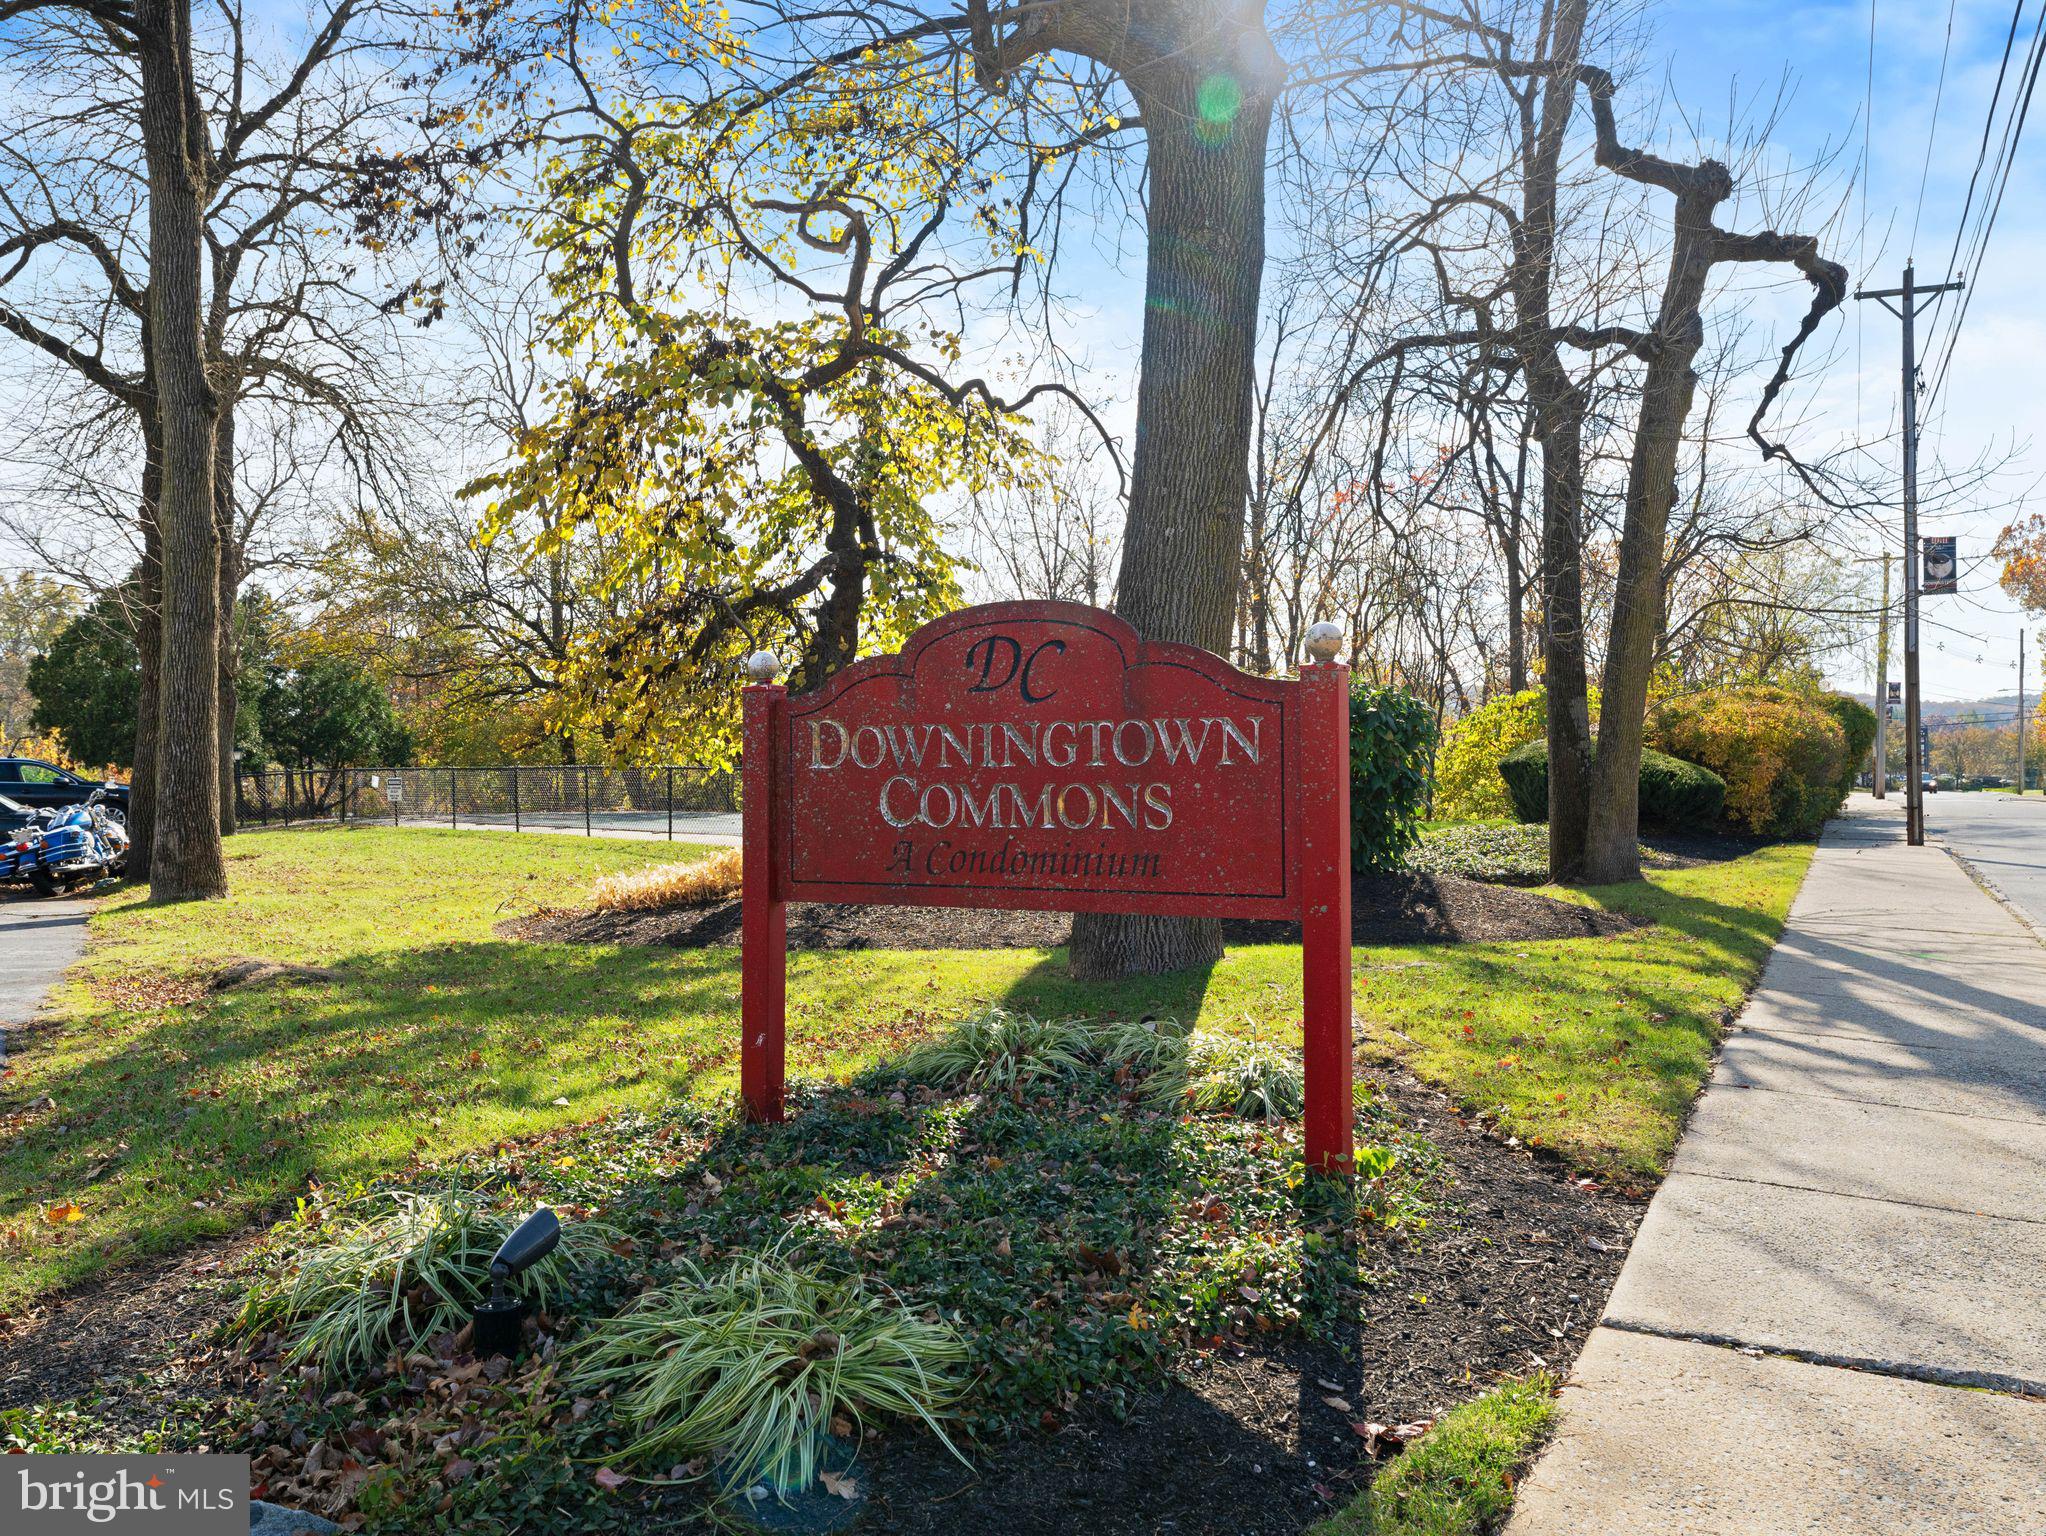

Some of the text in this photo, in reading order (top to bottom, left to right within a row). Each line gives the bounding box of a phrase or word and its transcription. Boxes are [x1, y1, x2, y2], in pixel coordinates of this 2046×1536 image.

[965, 635, 1067, 704] DC
[807, 715, 1265, 770] DOWNINGTOWN
[878, 774, 1174, 831] COMMONS
[886, 836, 1162, 878] A Condominium
